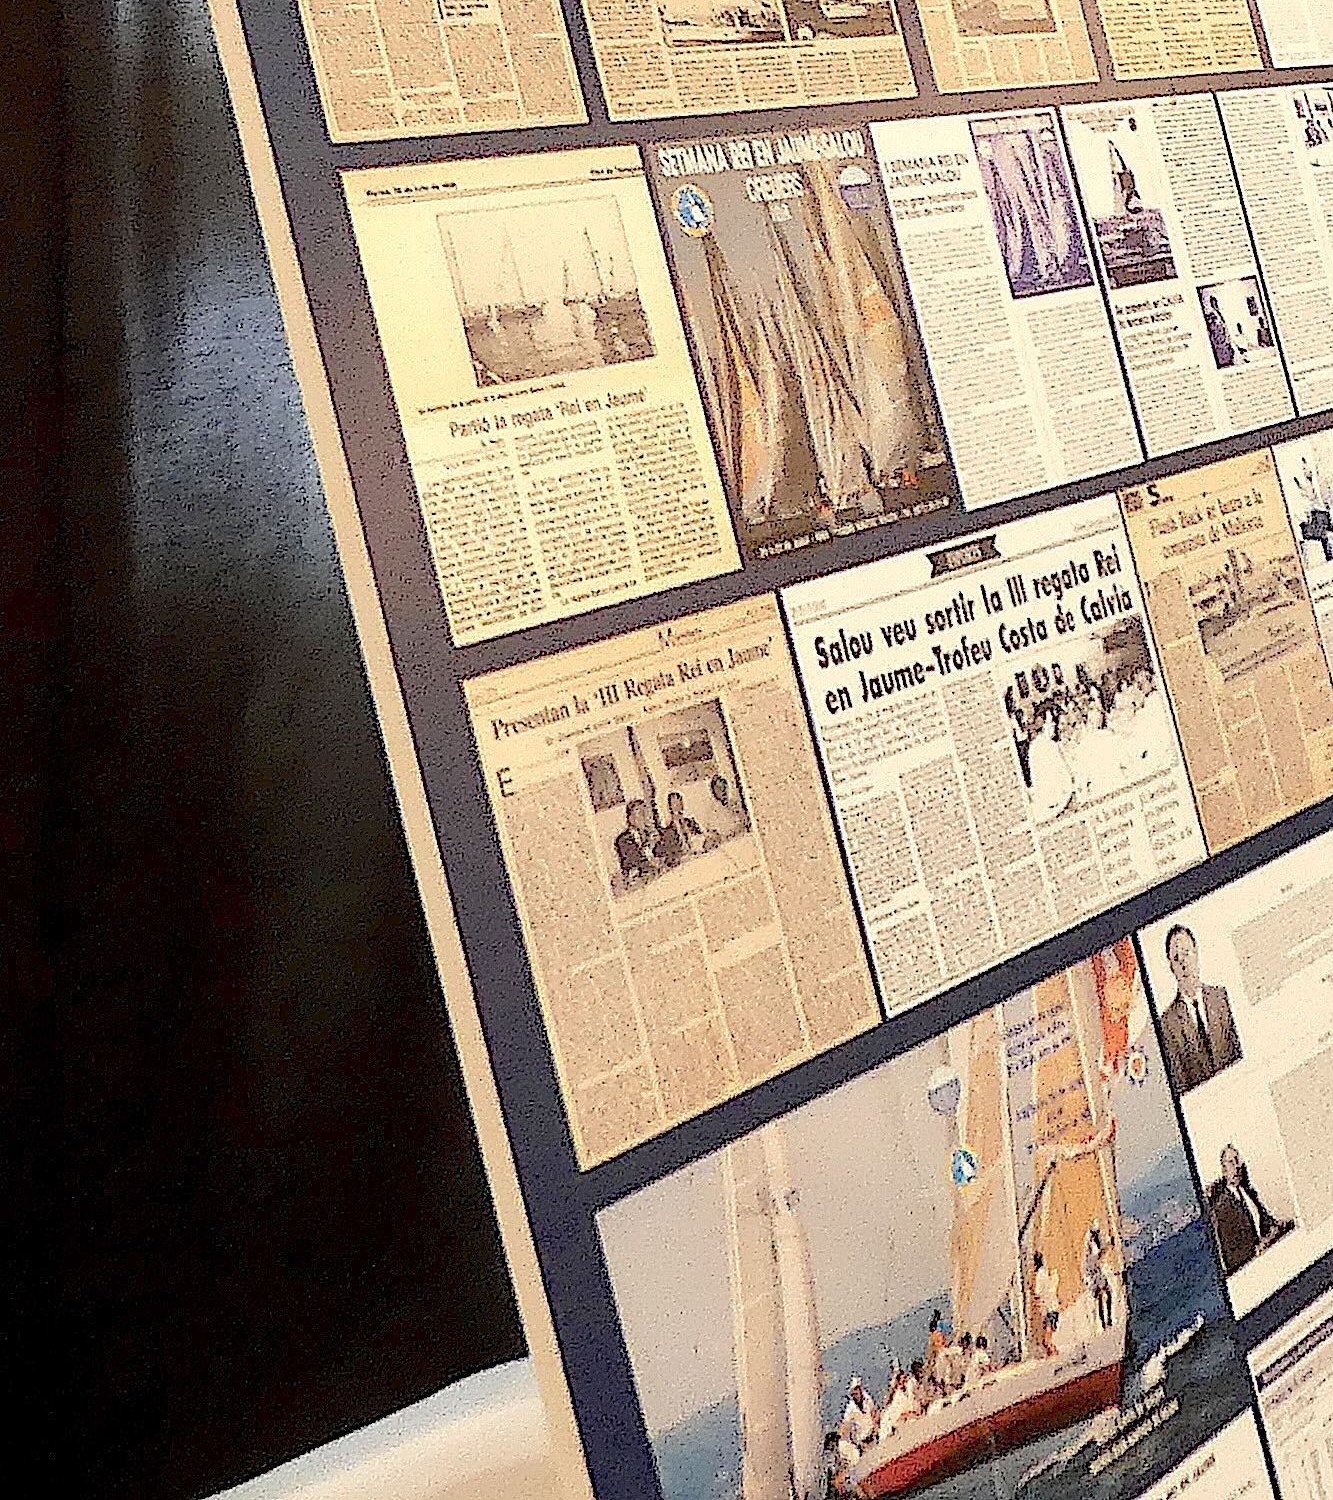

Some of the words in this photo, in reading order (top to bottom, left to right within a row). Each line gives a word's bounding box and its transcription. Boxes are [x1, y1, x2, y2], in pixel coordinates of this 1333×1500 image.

[658, 142, 730, 178] SETMANA
[728, 139, 755, 171] REI
[754, 137, 776, 167] EN
[495, 413, 508, 430] la
[512, 406, 553, 429] regata
[814, 628, 874, 669] Salou
[879, 617, 917, 648] veu
[924, 590, 977, 636] sortir
[980, 582, 1002, 615] la
[1005, 573, 1030, 608] III
[1032, 558, 1091, 601] regata
[1093, 543, 1123, 578] Rei
[491, 702, 571, 741] Presentan
[573, 694, 589, 716] la
[624, 672, 676, 702] Regata
[677, 658, 704, 684] Rei
[706, 658, 726, 675] en
[824, 684, 854, 716] en
[858, 633, 993, 703] Jaume-Trofeu
[998, 616, 1049, 655] Costa
[1054, 603, 1076, 635] de
